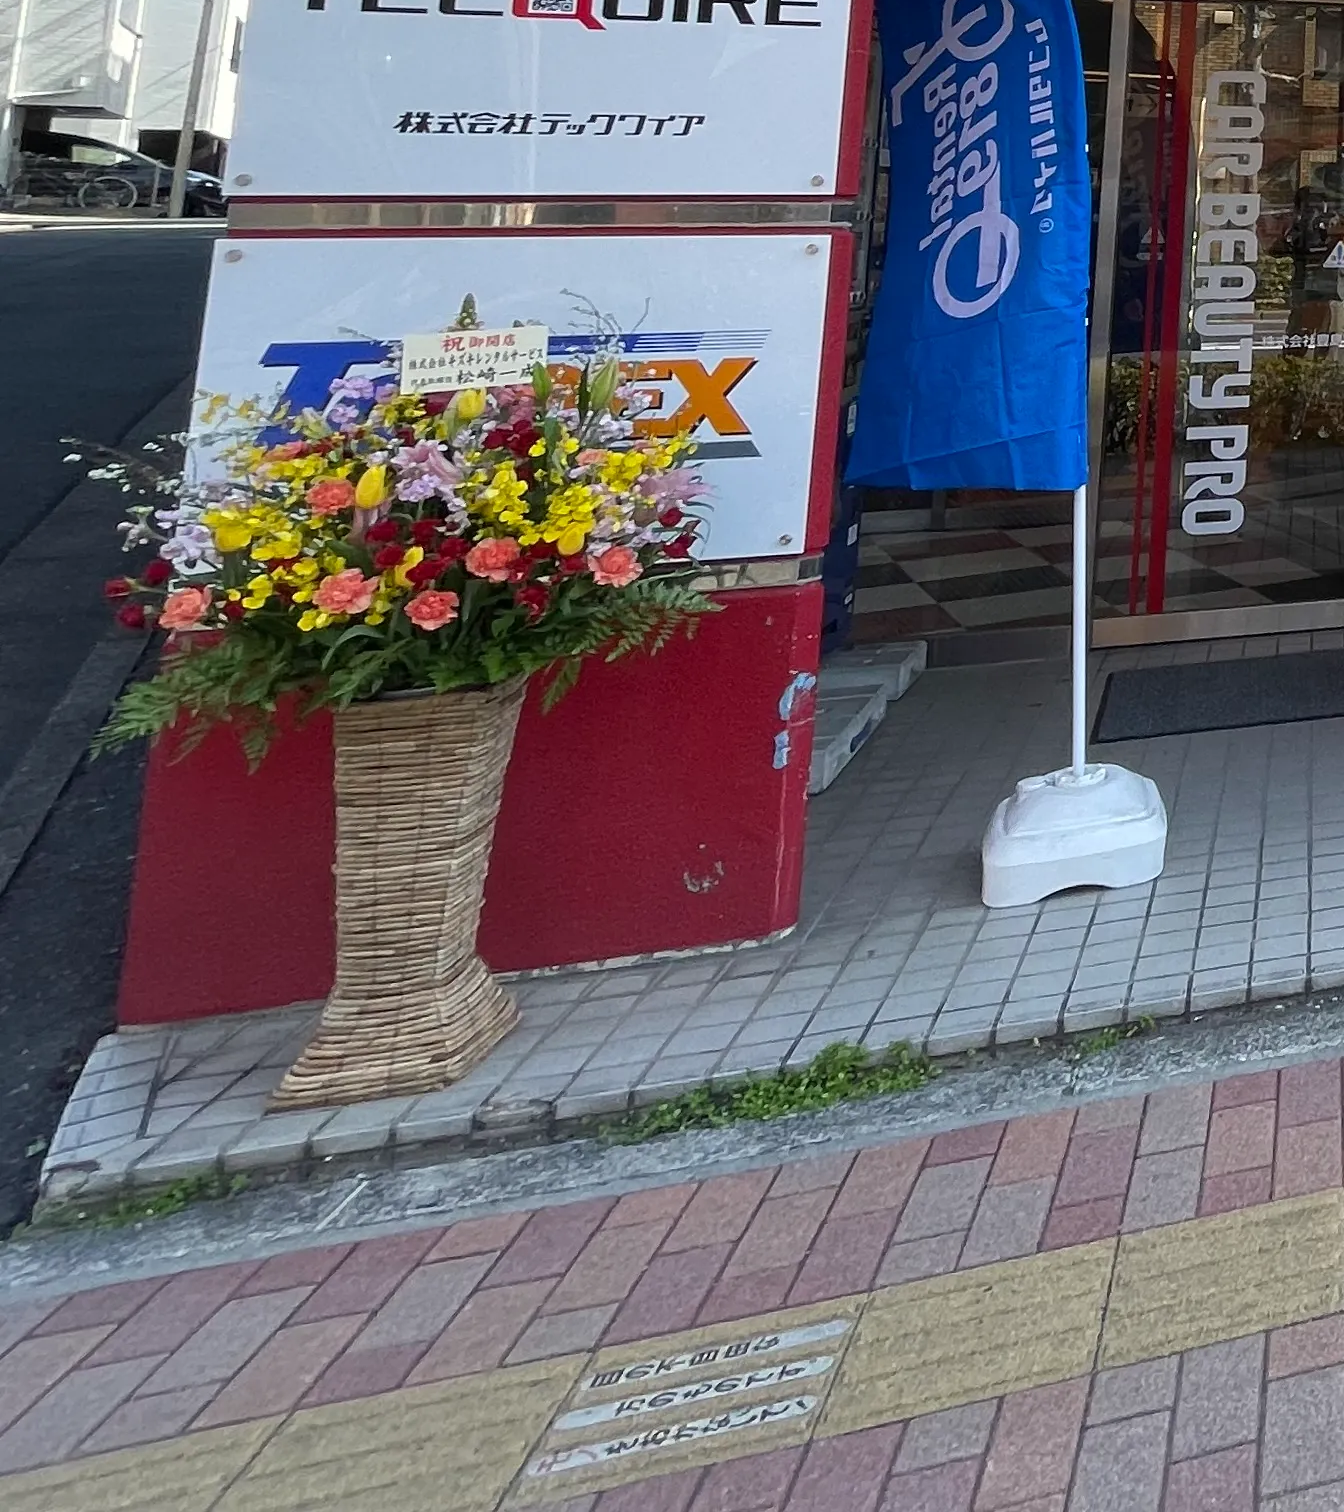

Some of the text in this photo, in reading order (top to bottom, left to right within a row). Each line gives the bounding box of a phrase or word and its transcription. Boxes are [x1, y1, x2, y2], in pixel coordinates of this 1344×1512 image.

[393, 111, 706, 139] 株式会社テックワイア
[1181, 70, 1267, 537] CAR BEAUTY PRO
